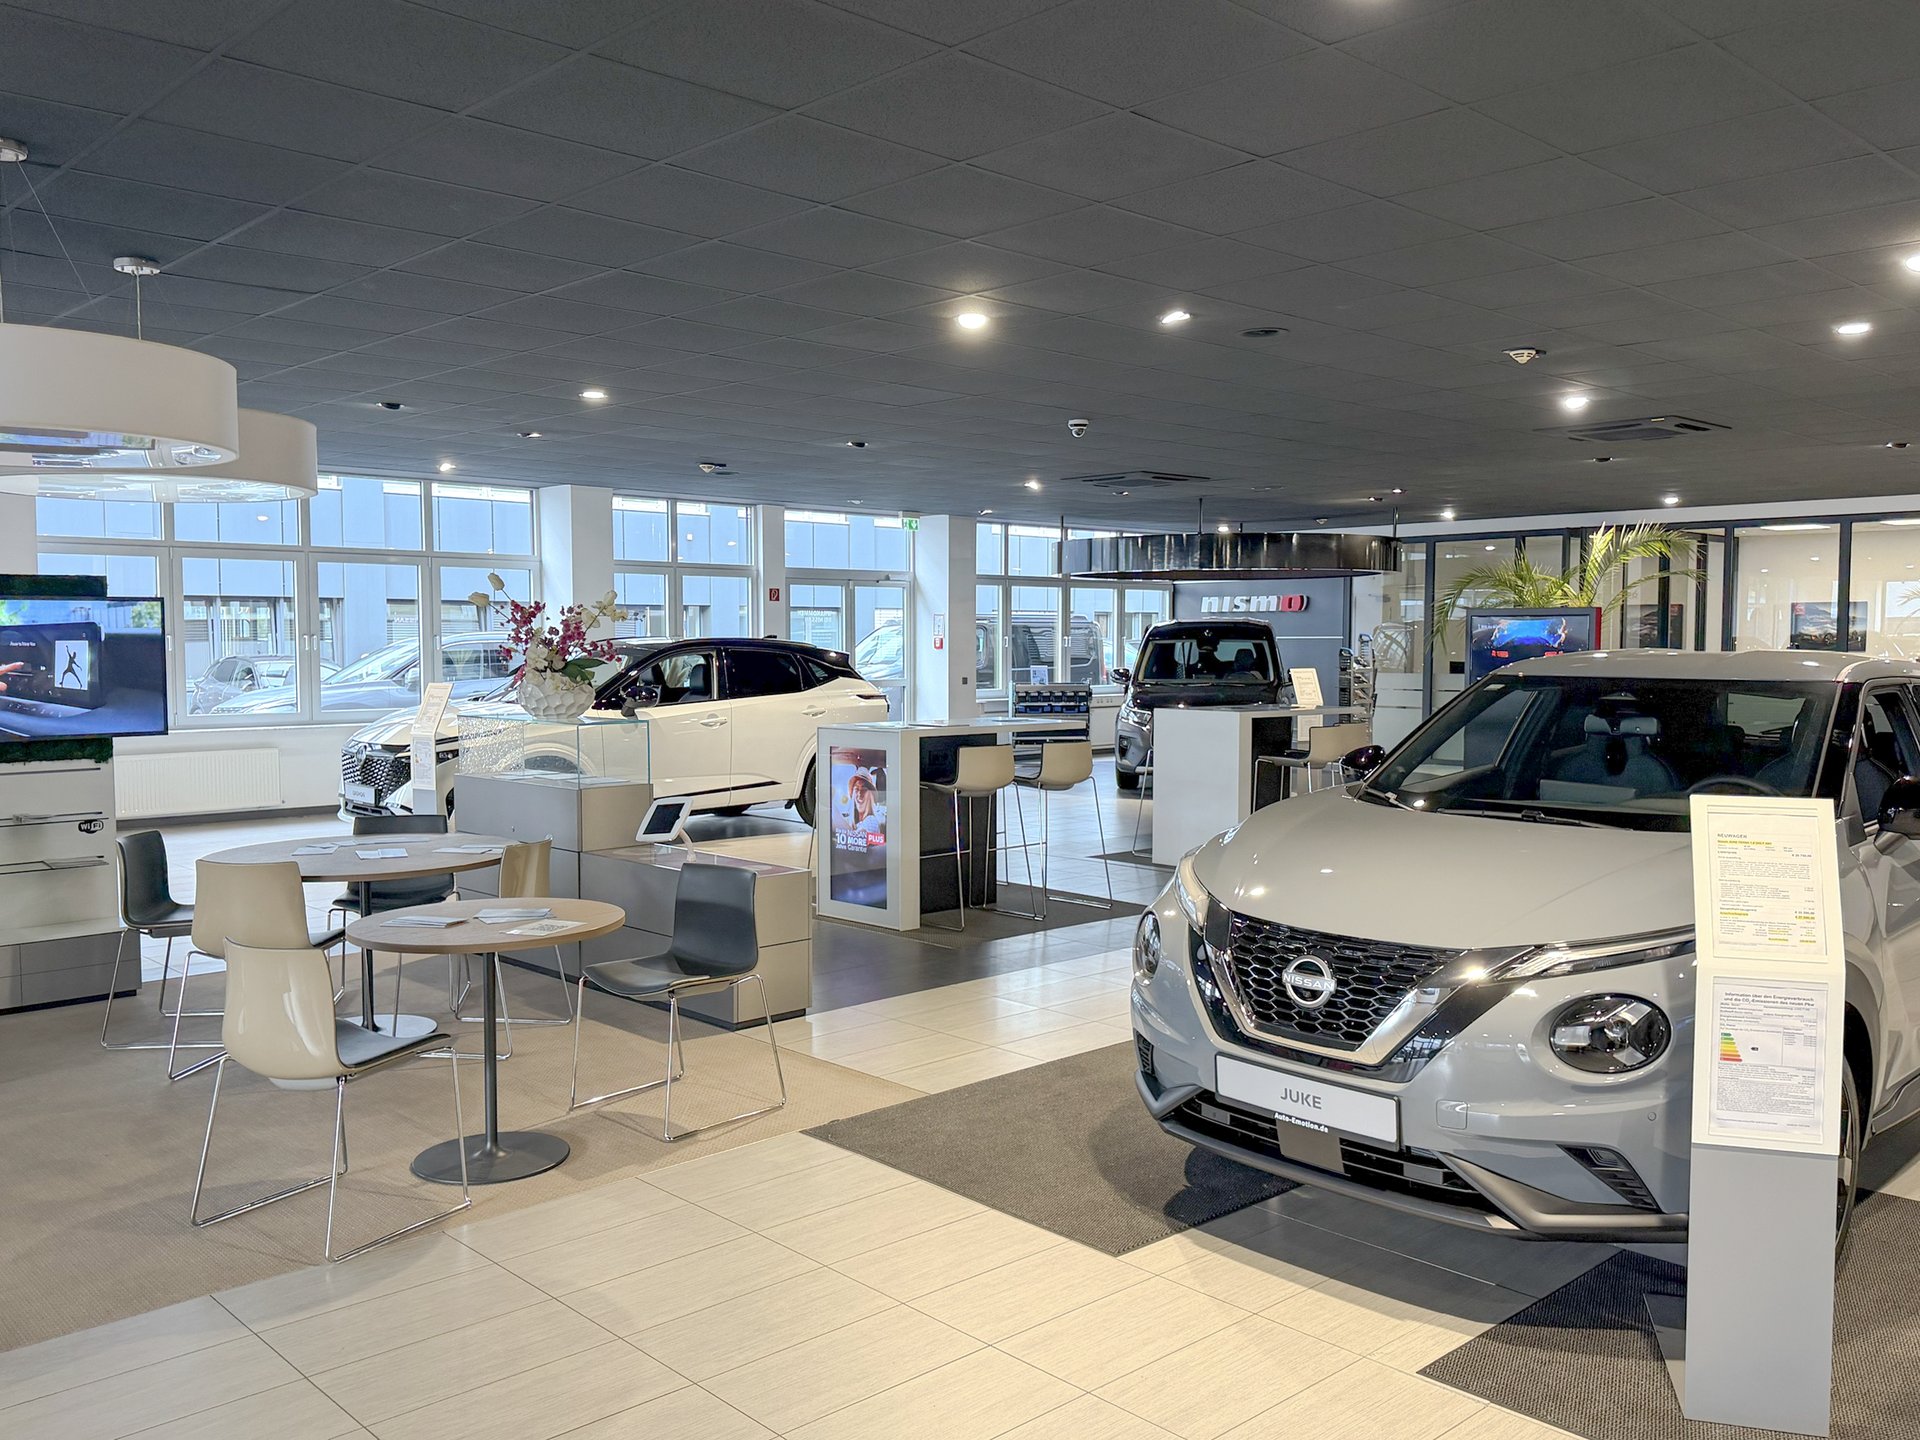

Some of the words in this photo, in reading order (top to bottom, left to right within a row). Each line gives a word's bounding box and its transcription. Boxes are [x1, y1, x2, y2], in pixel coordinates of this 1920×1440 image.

[835, 833, 847, 845] 10
[847, 838, 867, 847] MORE
[868, 834, 884, 844] PLUS
[1283, 973, 1335, 991] NISSAN
[1280, 1088, 1322, 1110] JUKE
[1274, 1112, 1329, 1133] Auto-Emotion.de
